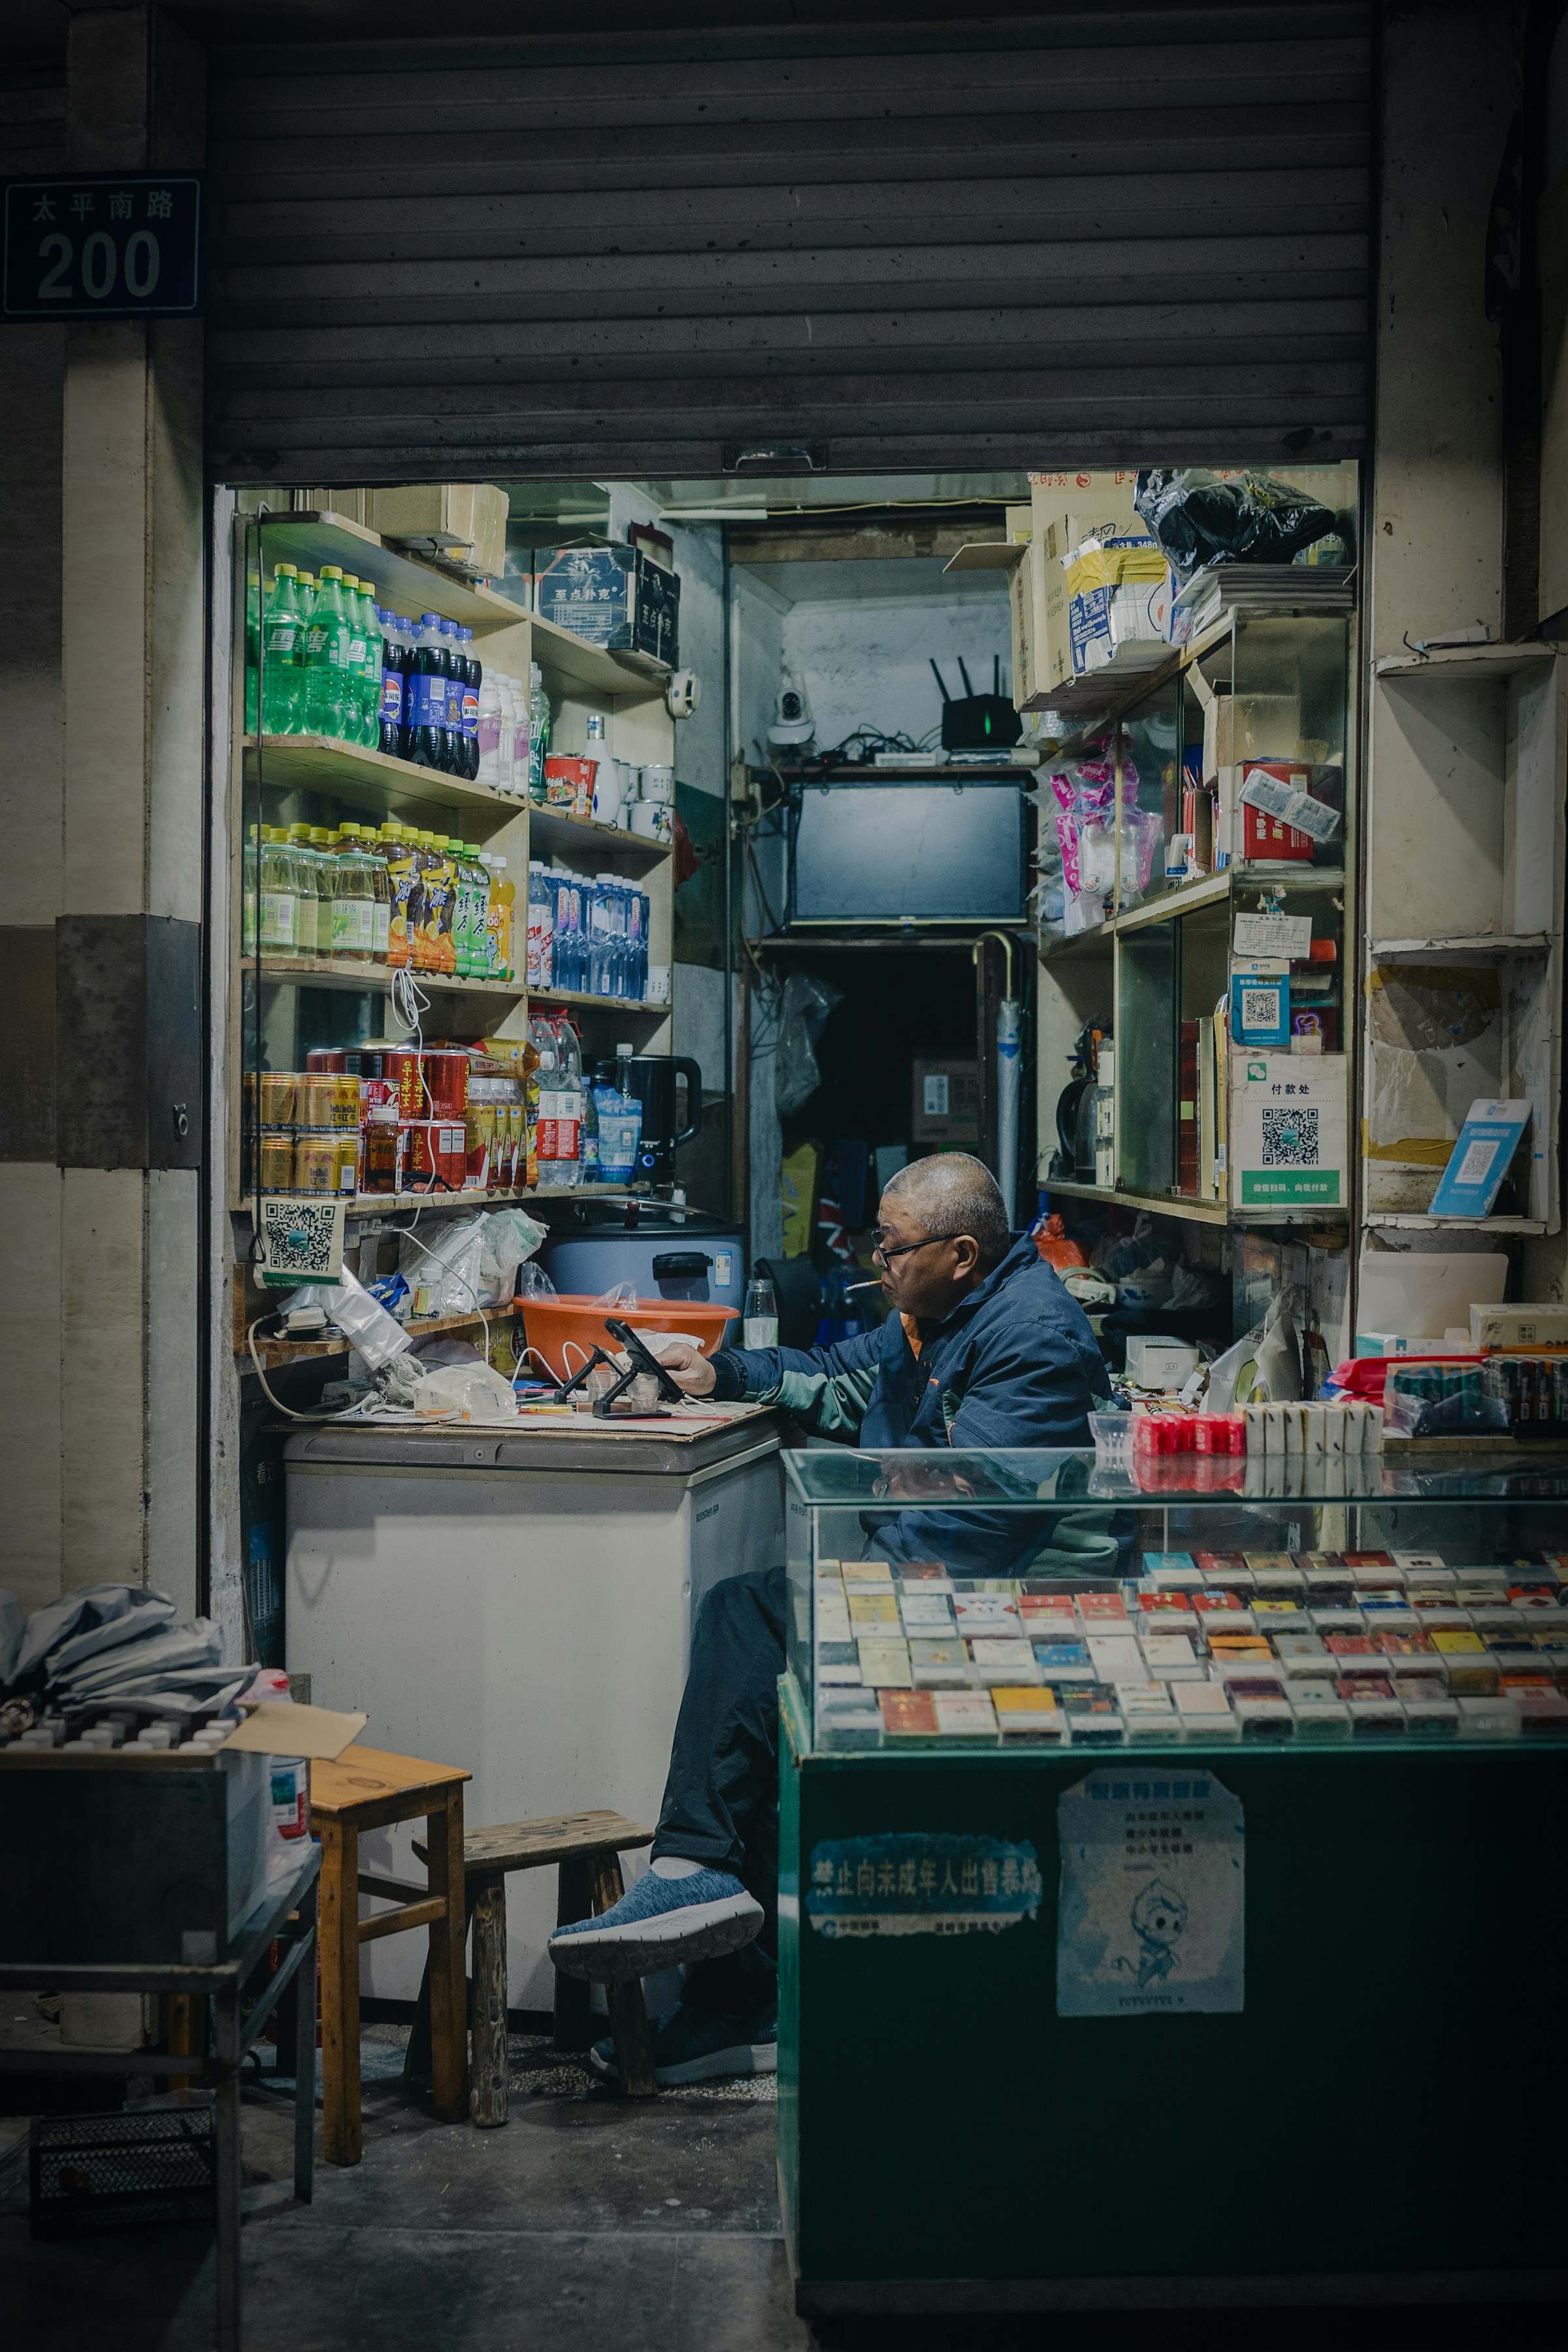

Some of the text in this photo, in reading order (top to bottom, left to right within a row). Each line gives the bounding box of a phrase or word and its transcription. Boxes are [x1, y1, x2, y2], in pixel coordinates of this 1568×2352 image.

[33, 189, 173, 221] 太平南路
[37, 231, 160, 299] 200
[1271, 1083, 1311, 1095] 付款处
